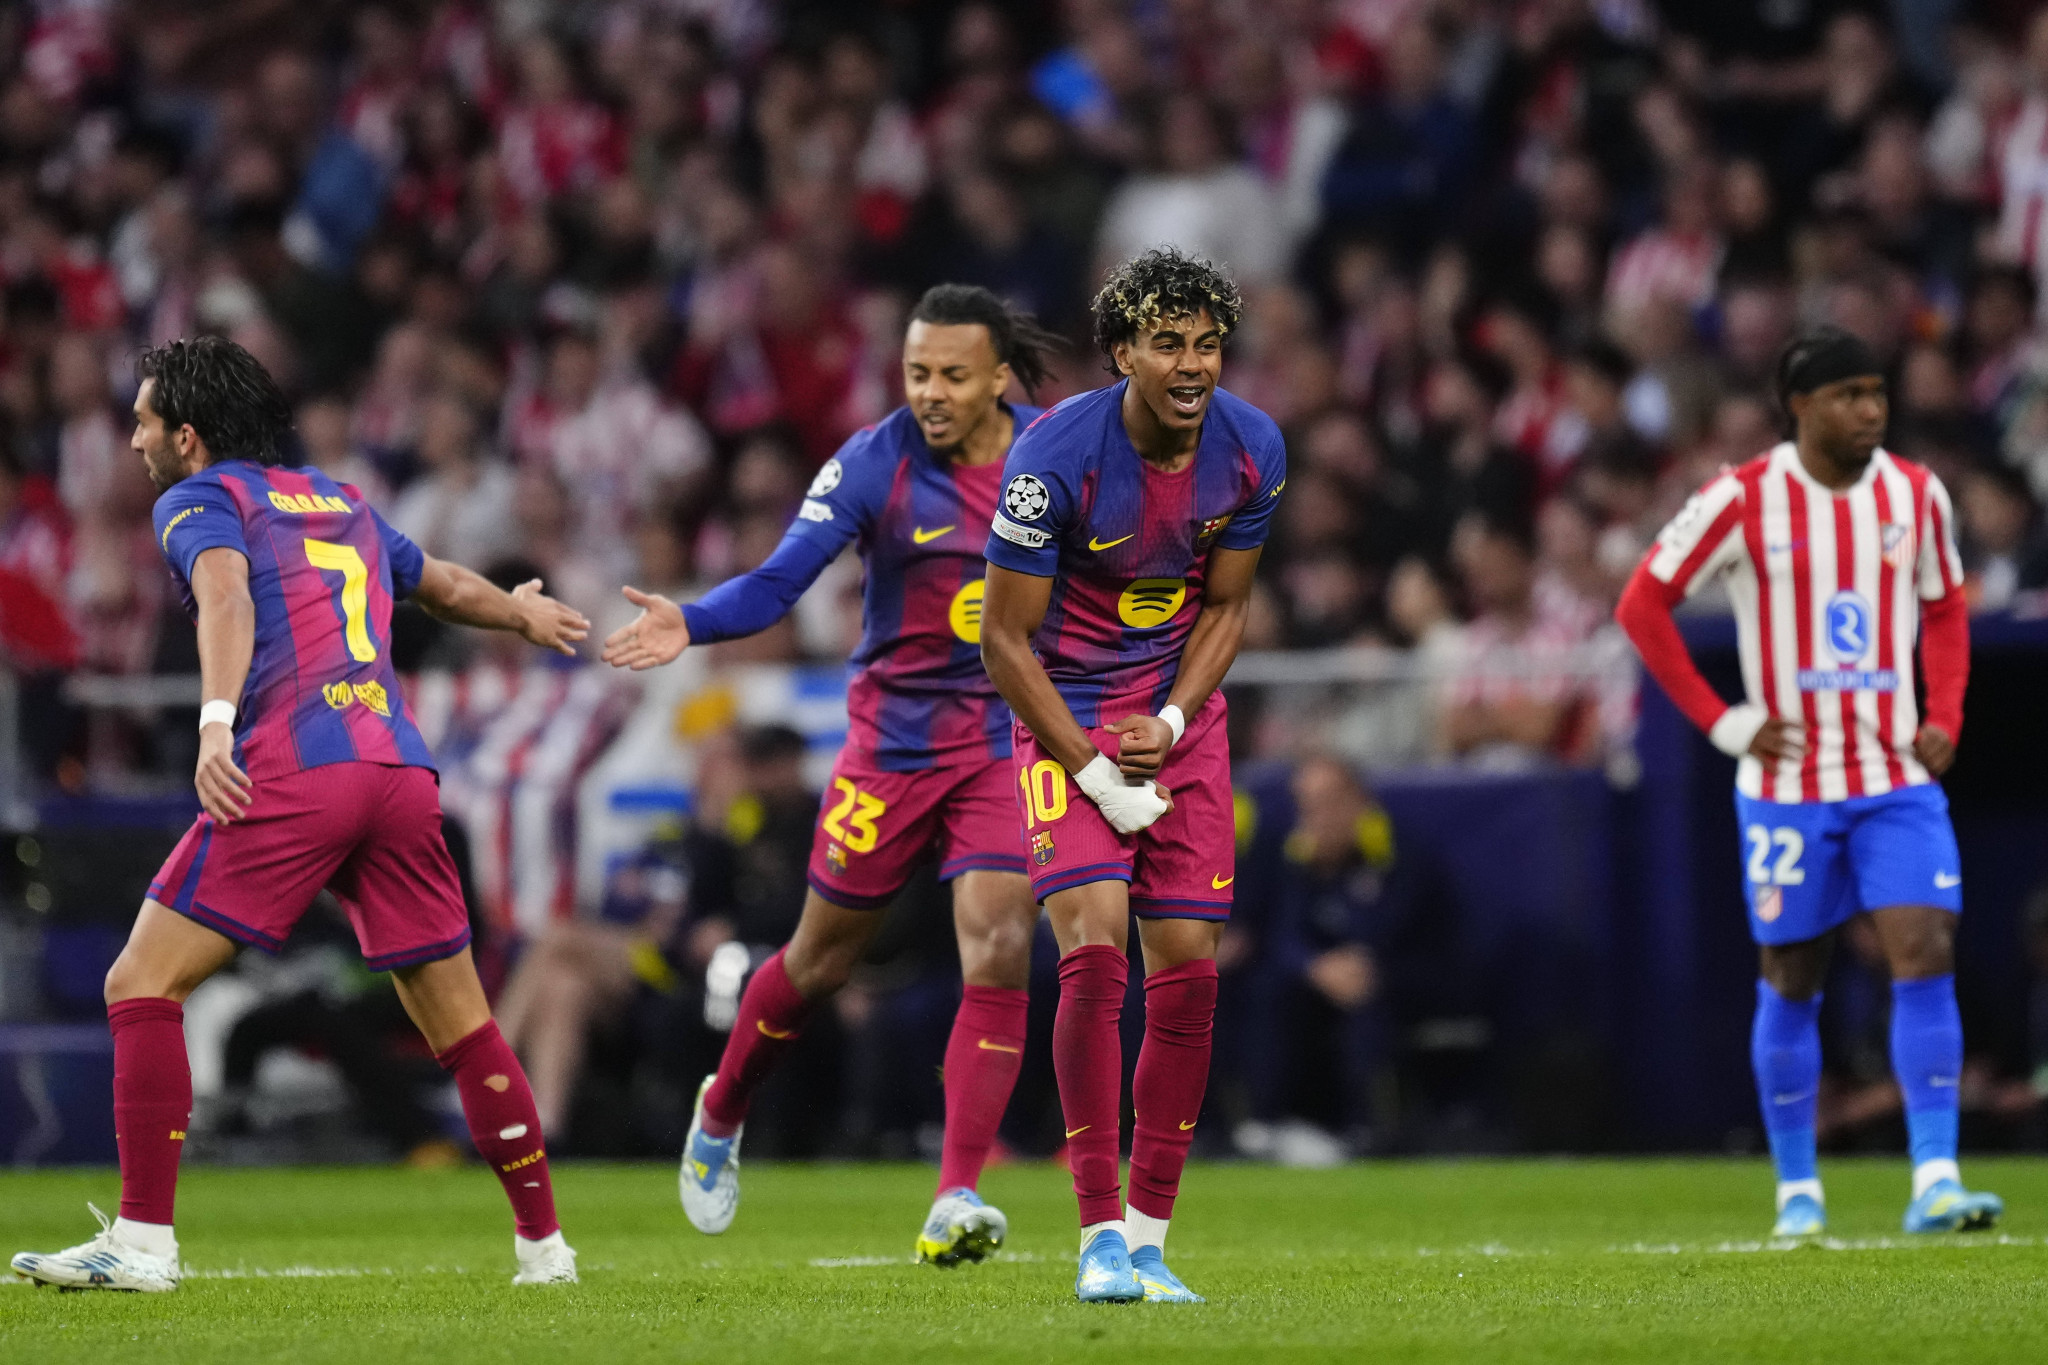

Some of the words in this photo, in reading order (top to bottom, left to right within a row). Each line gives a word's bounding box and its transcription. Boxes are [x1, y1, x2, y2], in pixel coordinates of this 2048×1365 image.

[1019, 489, 1033, 506] 5
[303, 537, 377, 663] 7
[822, 776, 888, 854] 23
[1019, 760, 1068, 831] 10
[1748, 823, 1806, 886] 22
